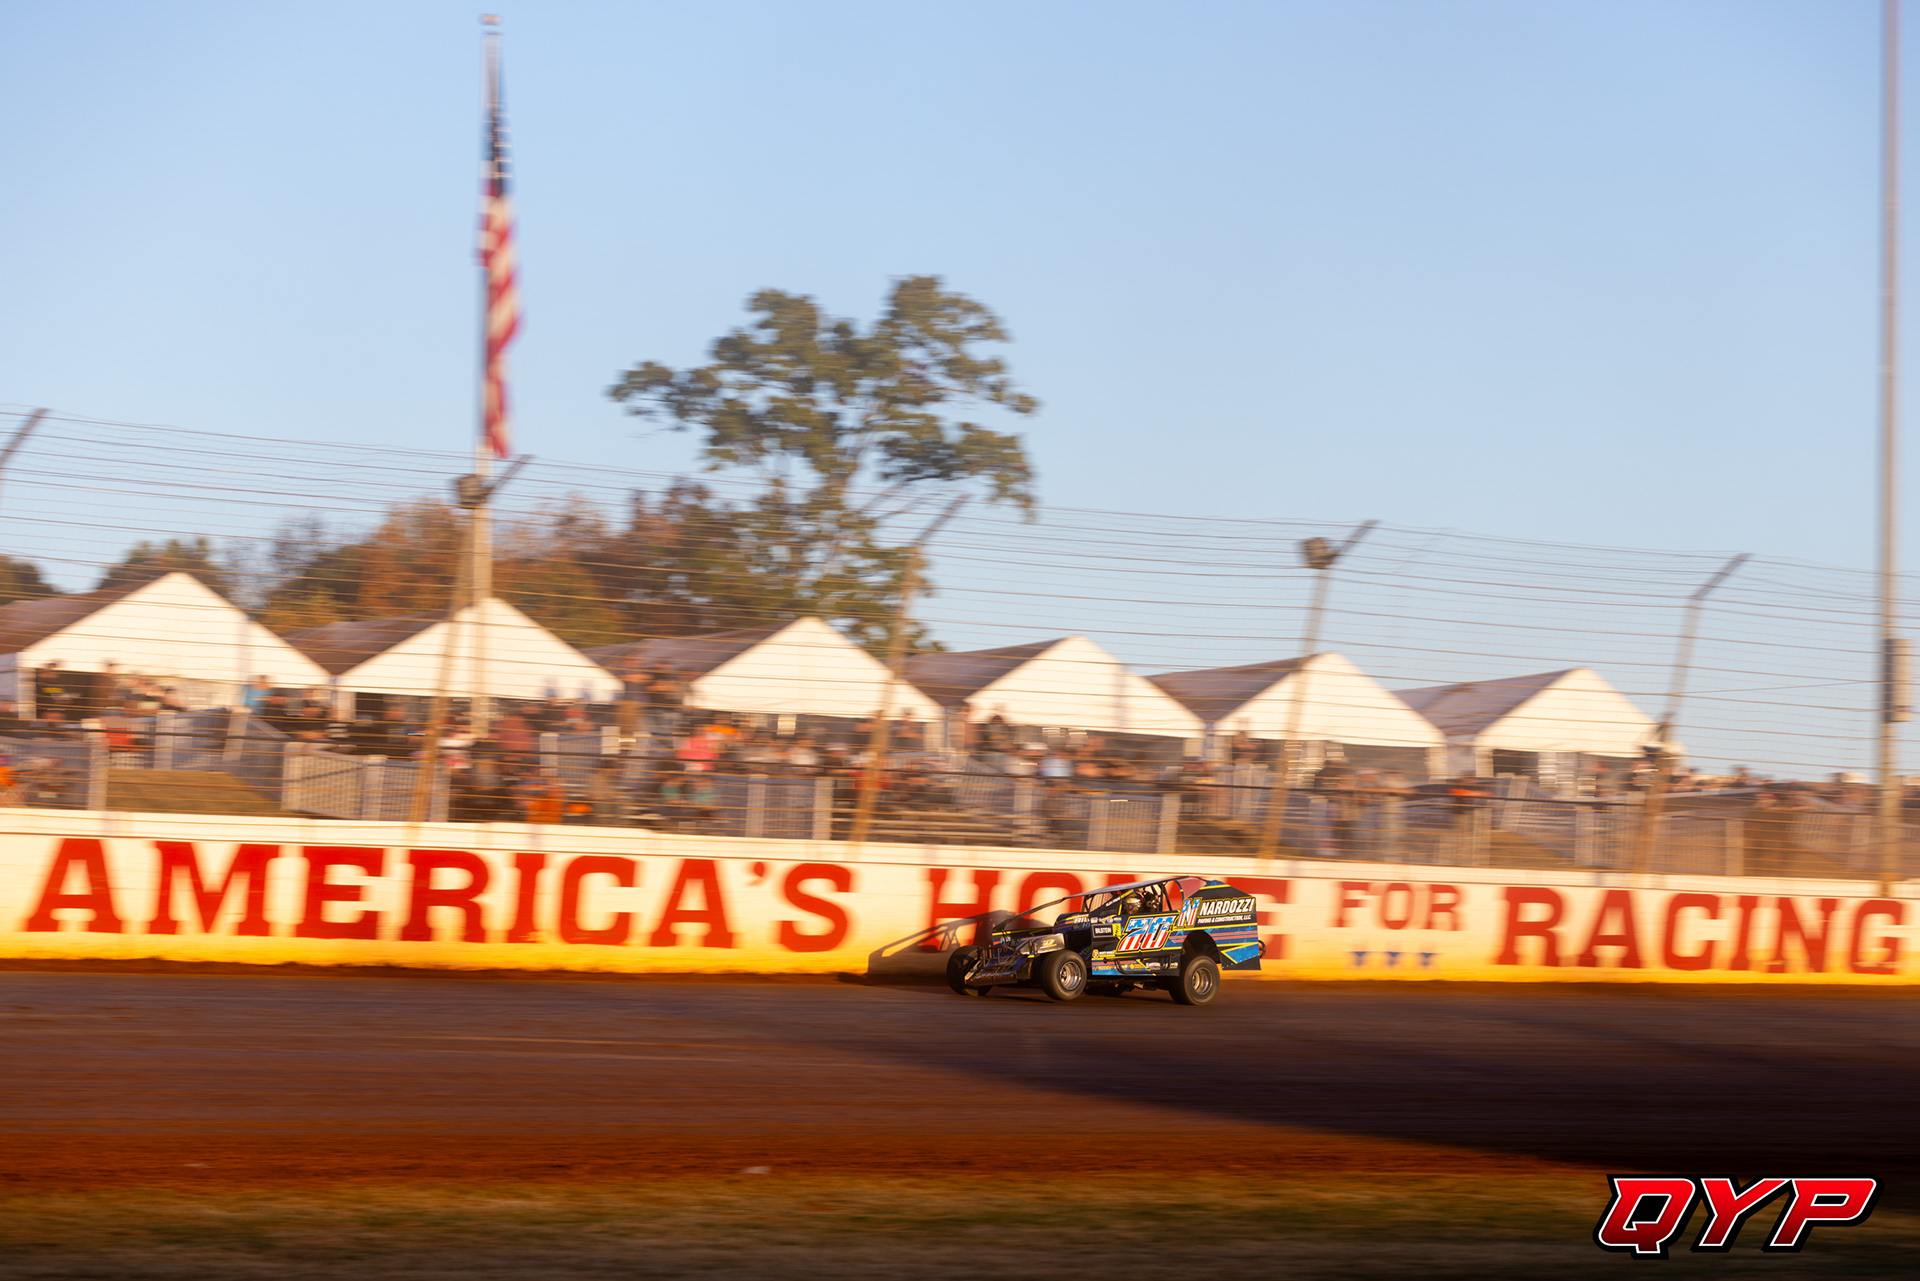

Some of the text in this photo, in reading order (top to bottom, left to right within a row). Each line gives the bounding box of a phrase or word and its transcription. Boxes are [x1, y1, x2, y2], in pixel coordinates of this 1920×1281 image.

[23, 838, 1906, 975] AMERICA'S HOE FOR RACING
[1199, 898, 1256, 916] NARDOZZI
